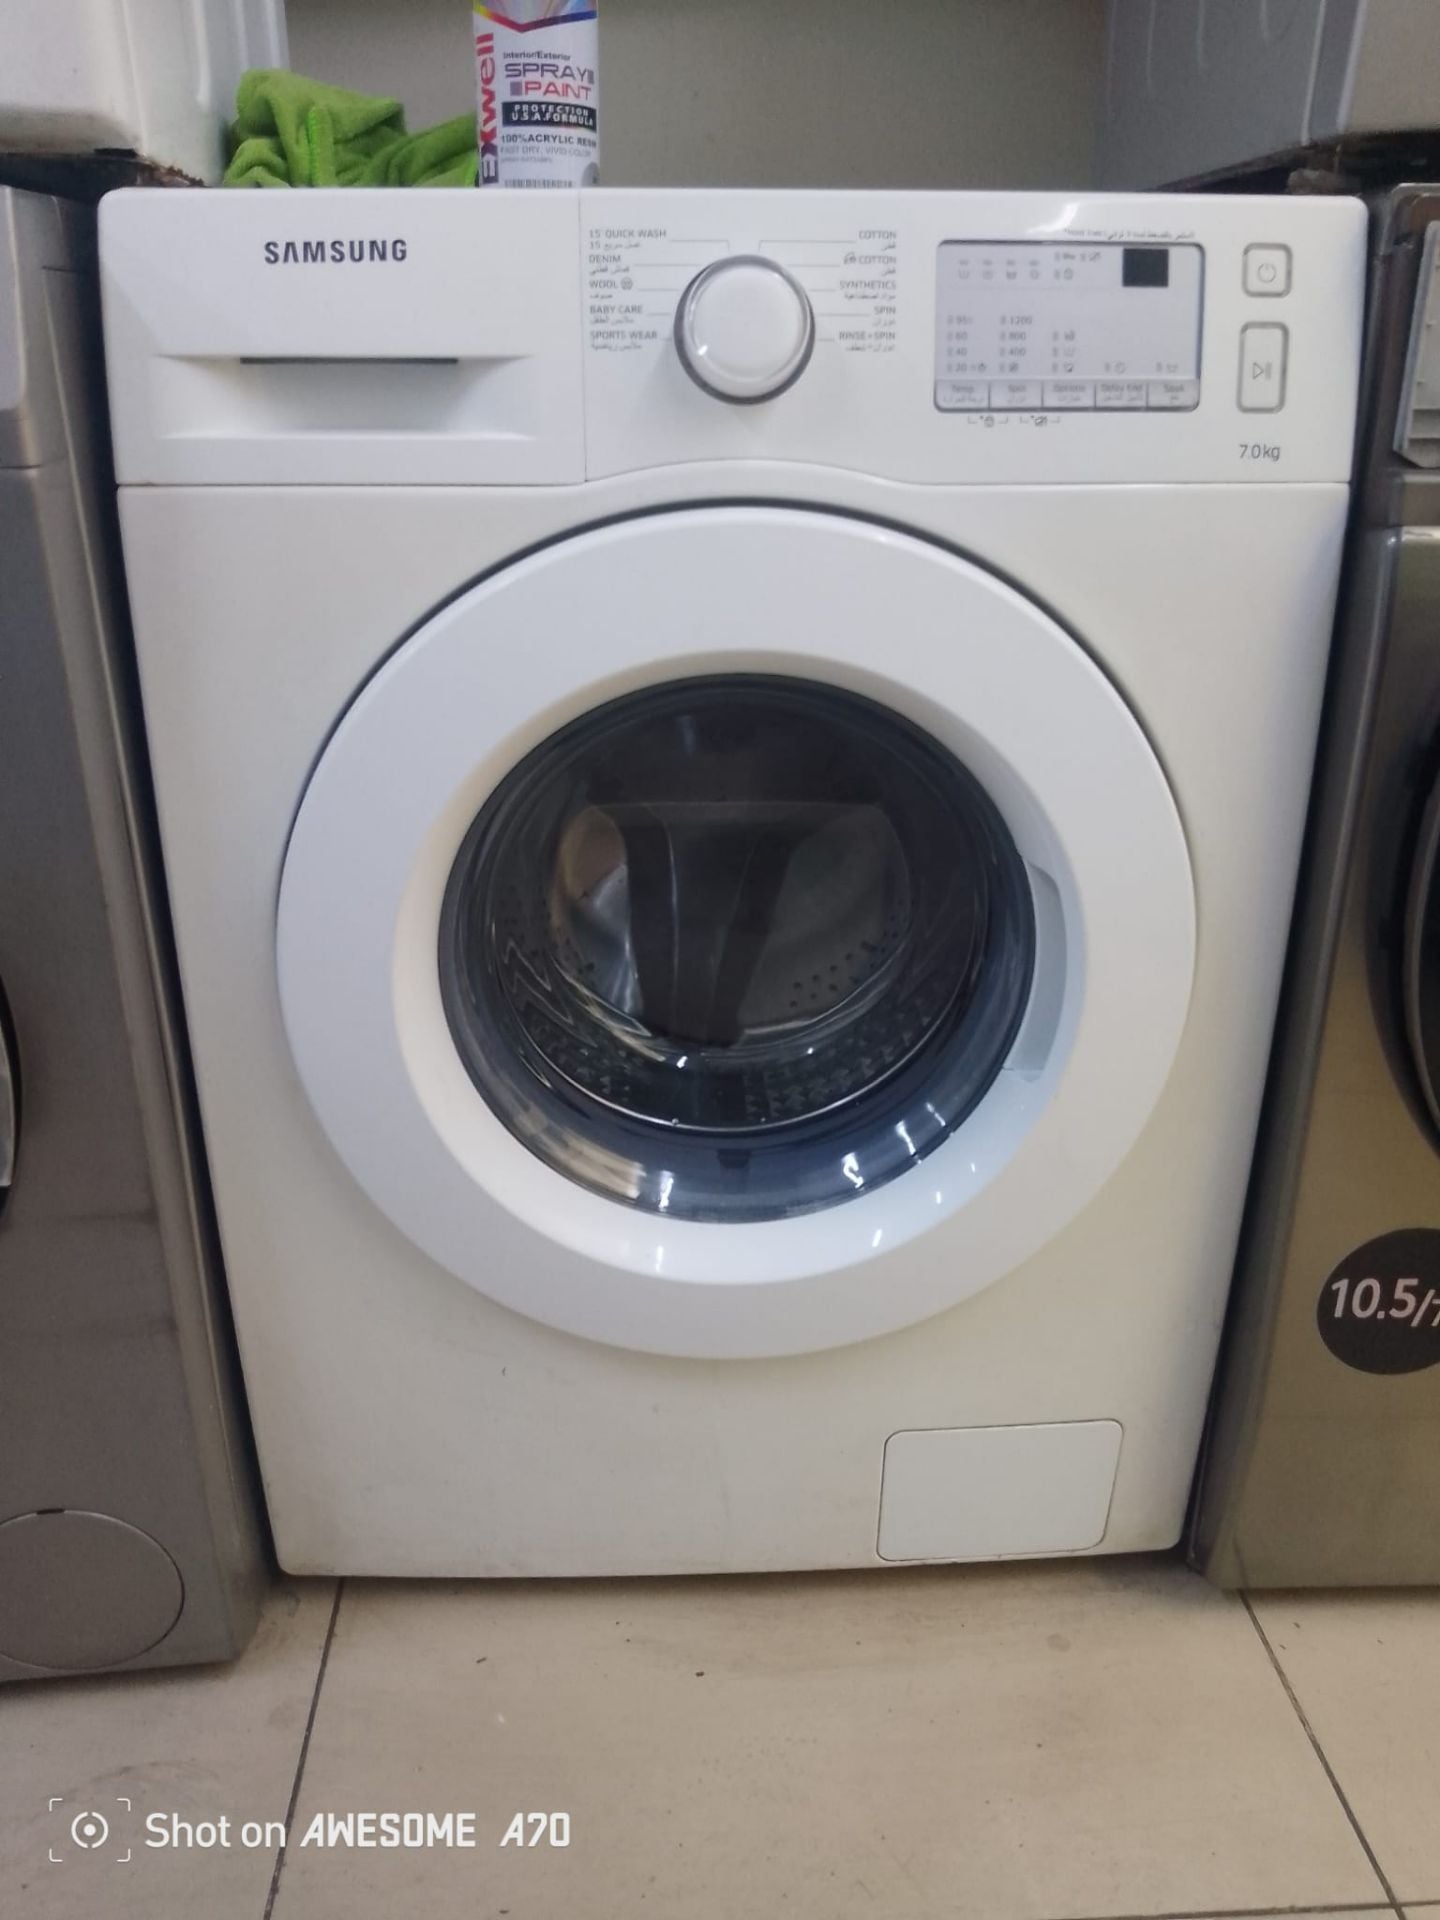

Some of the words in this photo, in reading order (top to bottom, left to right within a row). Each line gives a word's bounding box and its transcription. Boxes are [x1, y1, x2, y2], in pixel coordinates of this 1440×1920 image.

[504, 62, 587, 82] SPRAY
[524, 81, 592, 100] PAINT
[514, 104, 589, 117] PROTECTION
[604, 229, 635, 239] QUICK
[637, 229, 667, 239] WASH
[859, 230, 897, 240] COTTON
[264, 239, 407, 264] SAMSUNG
[589, 255, 622, 264] DENIM
[859, 255, 897, 265] COTTON
[589, 280, 618, 289] WOOL
[840, 280, 897, 290] SYNTHETICS
[590, 305, 616, 315] BABY
[618, 305, 643, 315] CARE
[874, 305, 897, 315] SPIN
[589, 330, 626, 340] SPORTS
[629, 330, 658, 340] WEAR
[874, 331, 896, 340] SPIN
